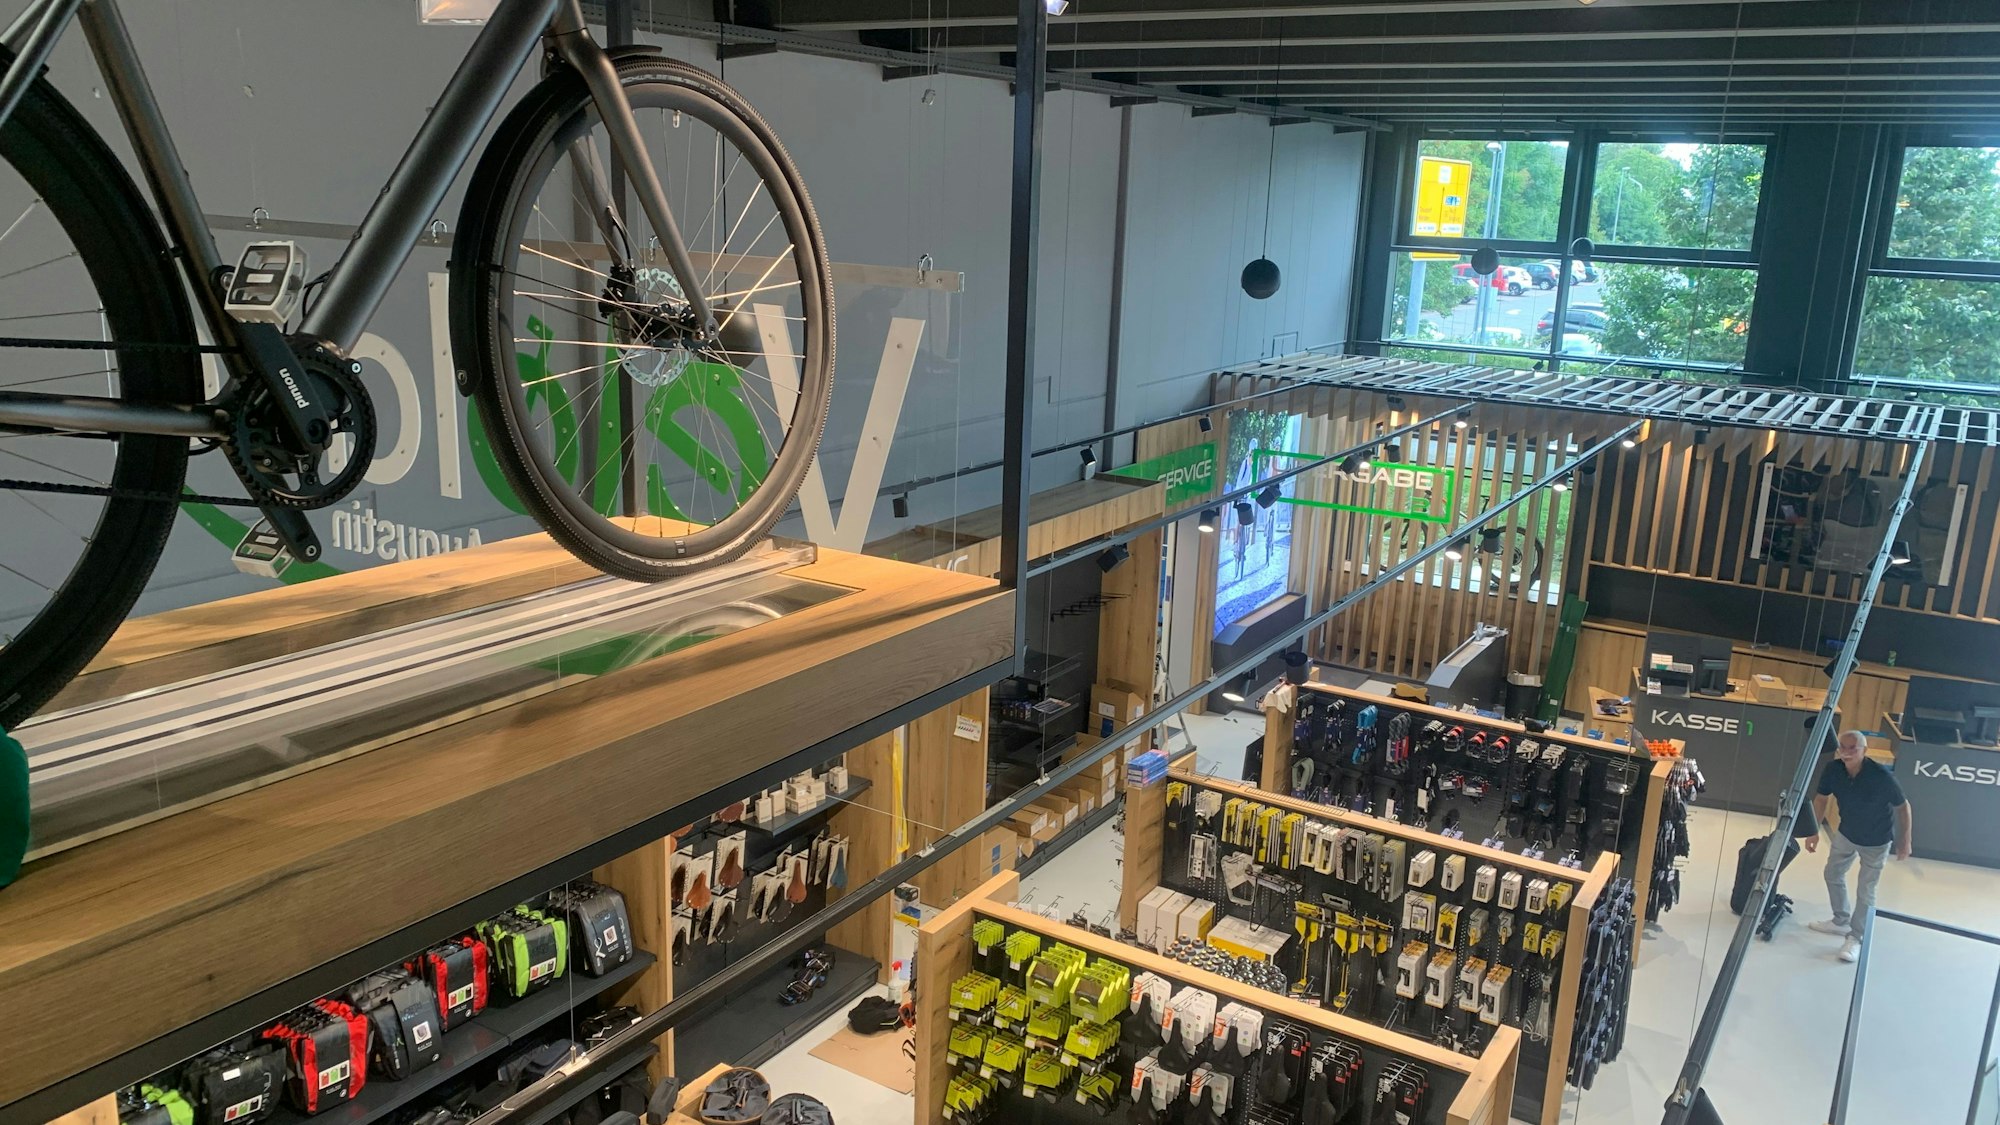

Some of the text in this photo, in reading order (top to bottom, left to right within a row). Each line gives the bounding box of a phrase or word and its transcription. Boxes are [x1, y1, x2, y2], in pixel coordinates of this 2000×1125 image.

[278, 367, 310, 409] pinion
[1651, 709, 1754, 736] KASSE 1
[1914, 760, 2000, 786] KASS
